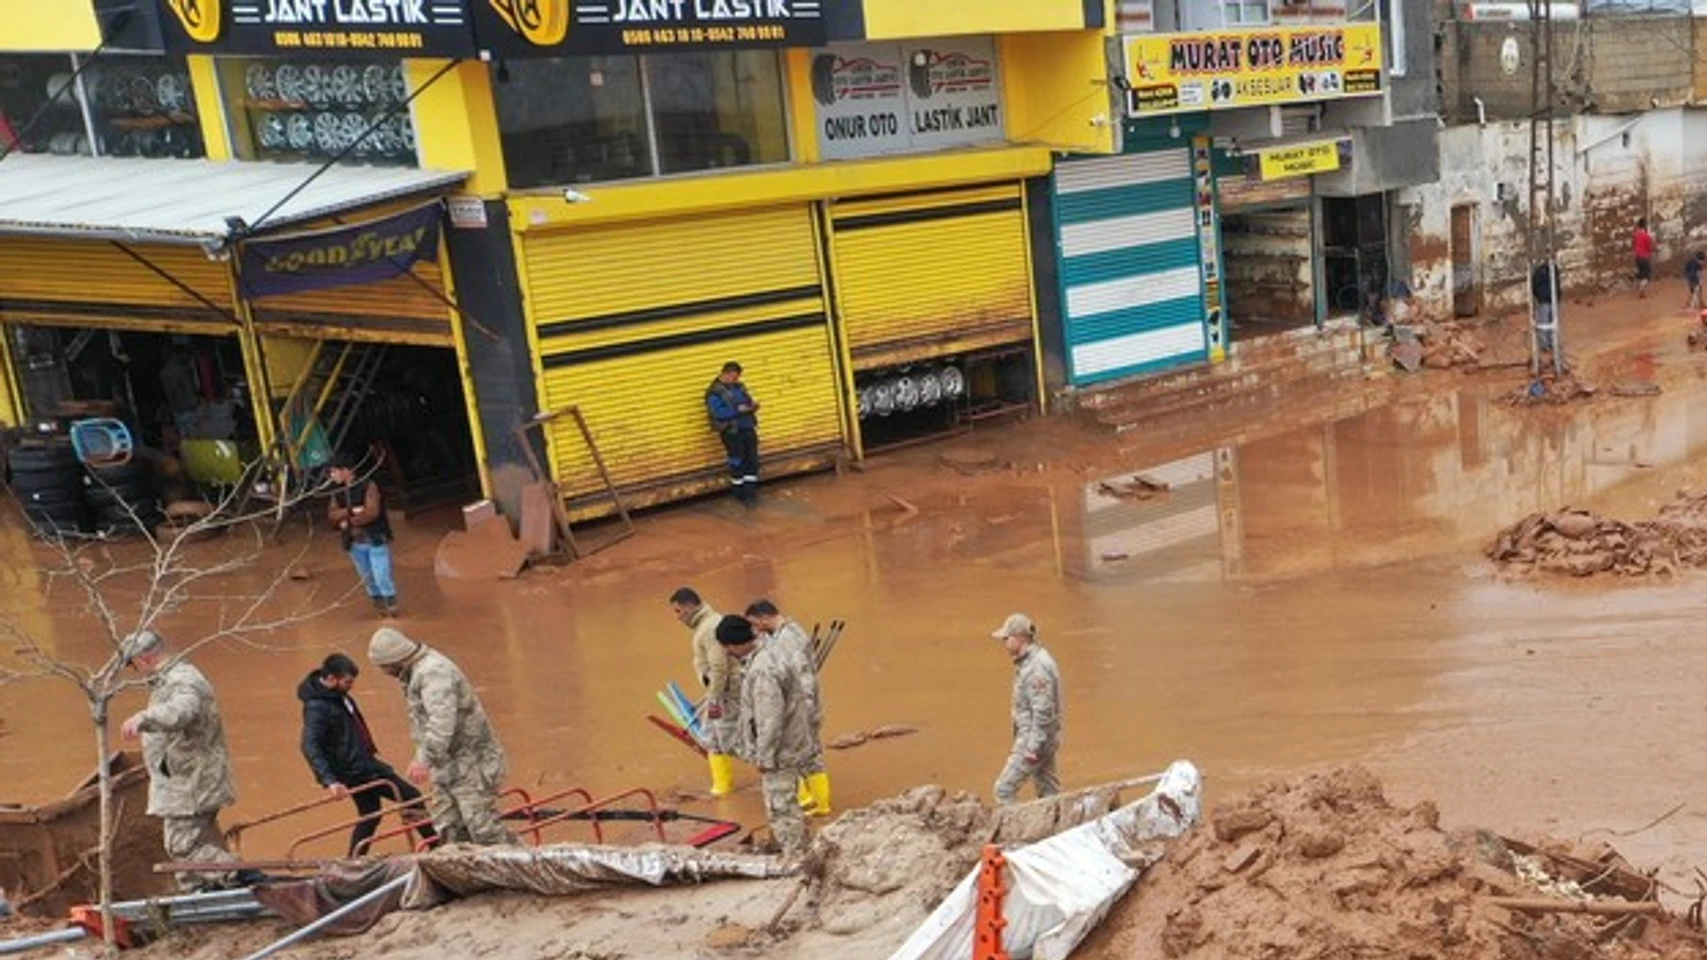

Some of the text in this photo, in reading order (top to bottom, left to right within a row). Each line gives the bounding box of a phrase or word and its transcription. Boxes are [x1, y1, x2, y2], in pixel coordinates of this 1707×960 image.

[264, 0, 327, 22] JANT
[612, 0, 684, 21] JANT
[1169, 40, 1242, 70] MURAT
[825, 112, 898, 140] ONUR OTO
[967, 104, 998, 127] JANT
